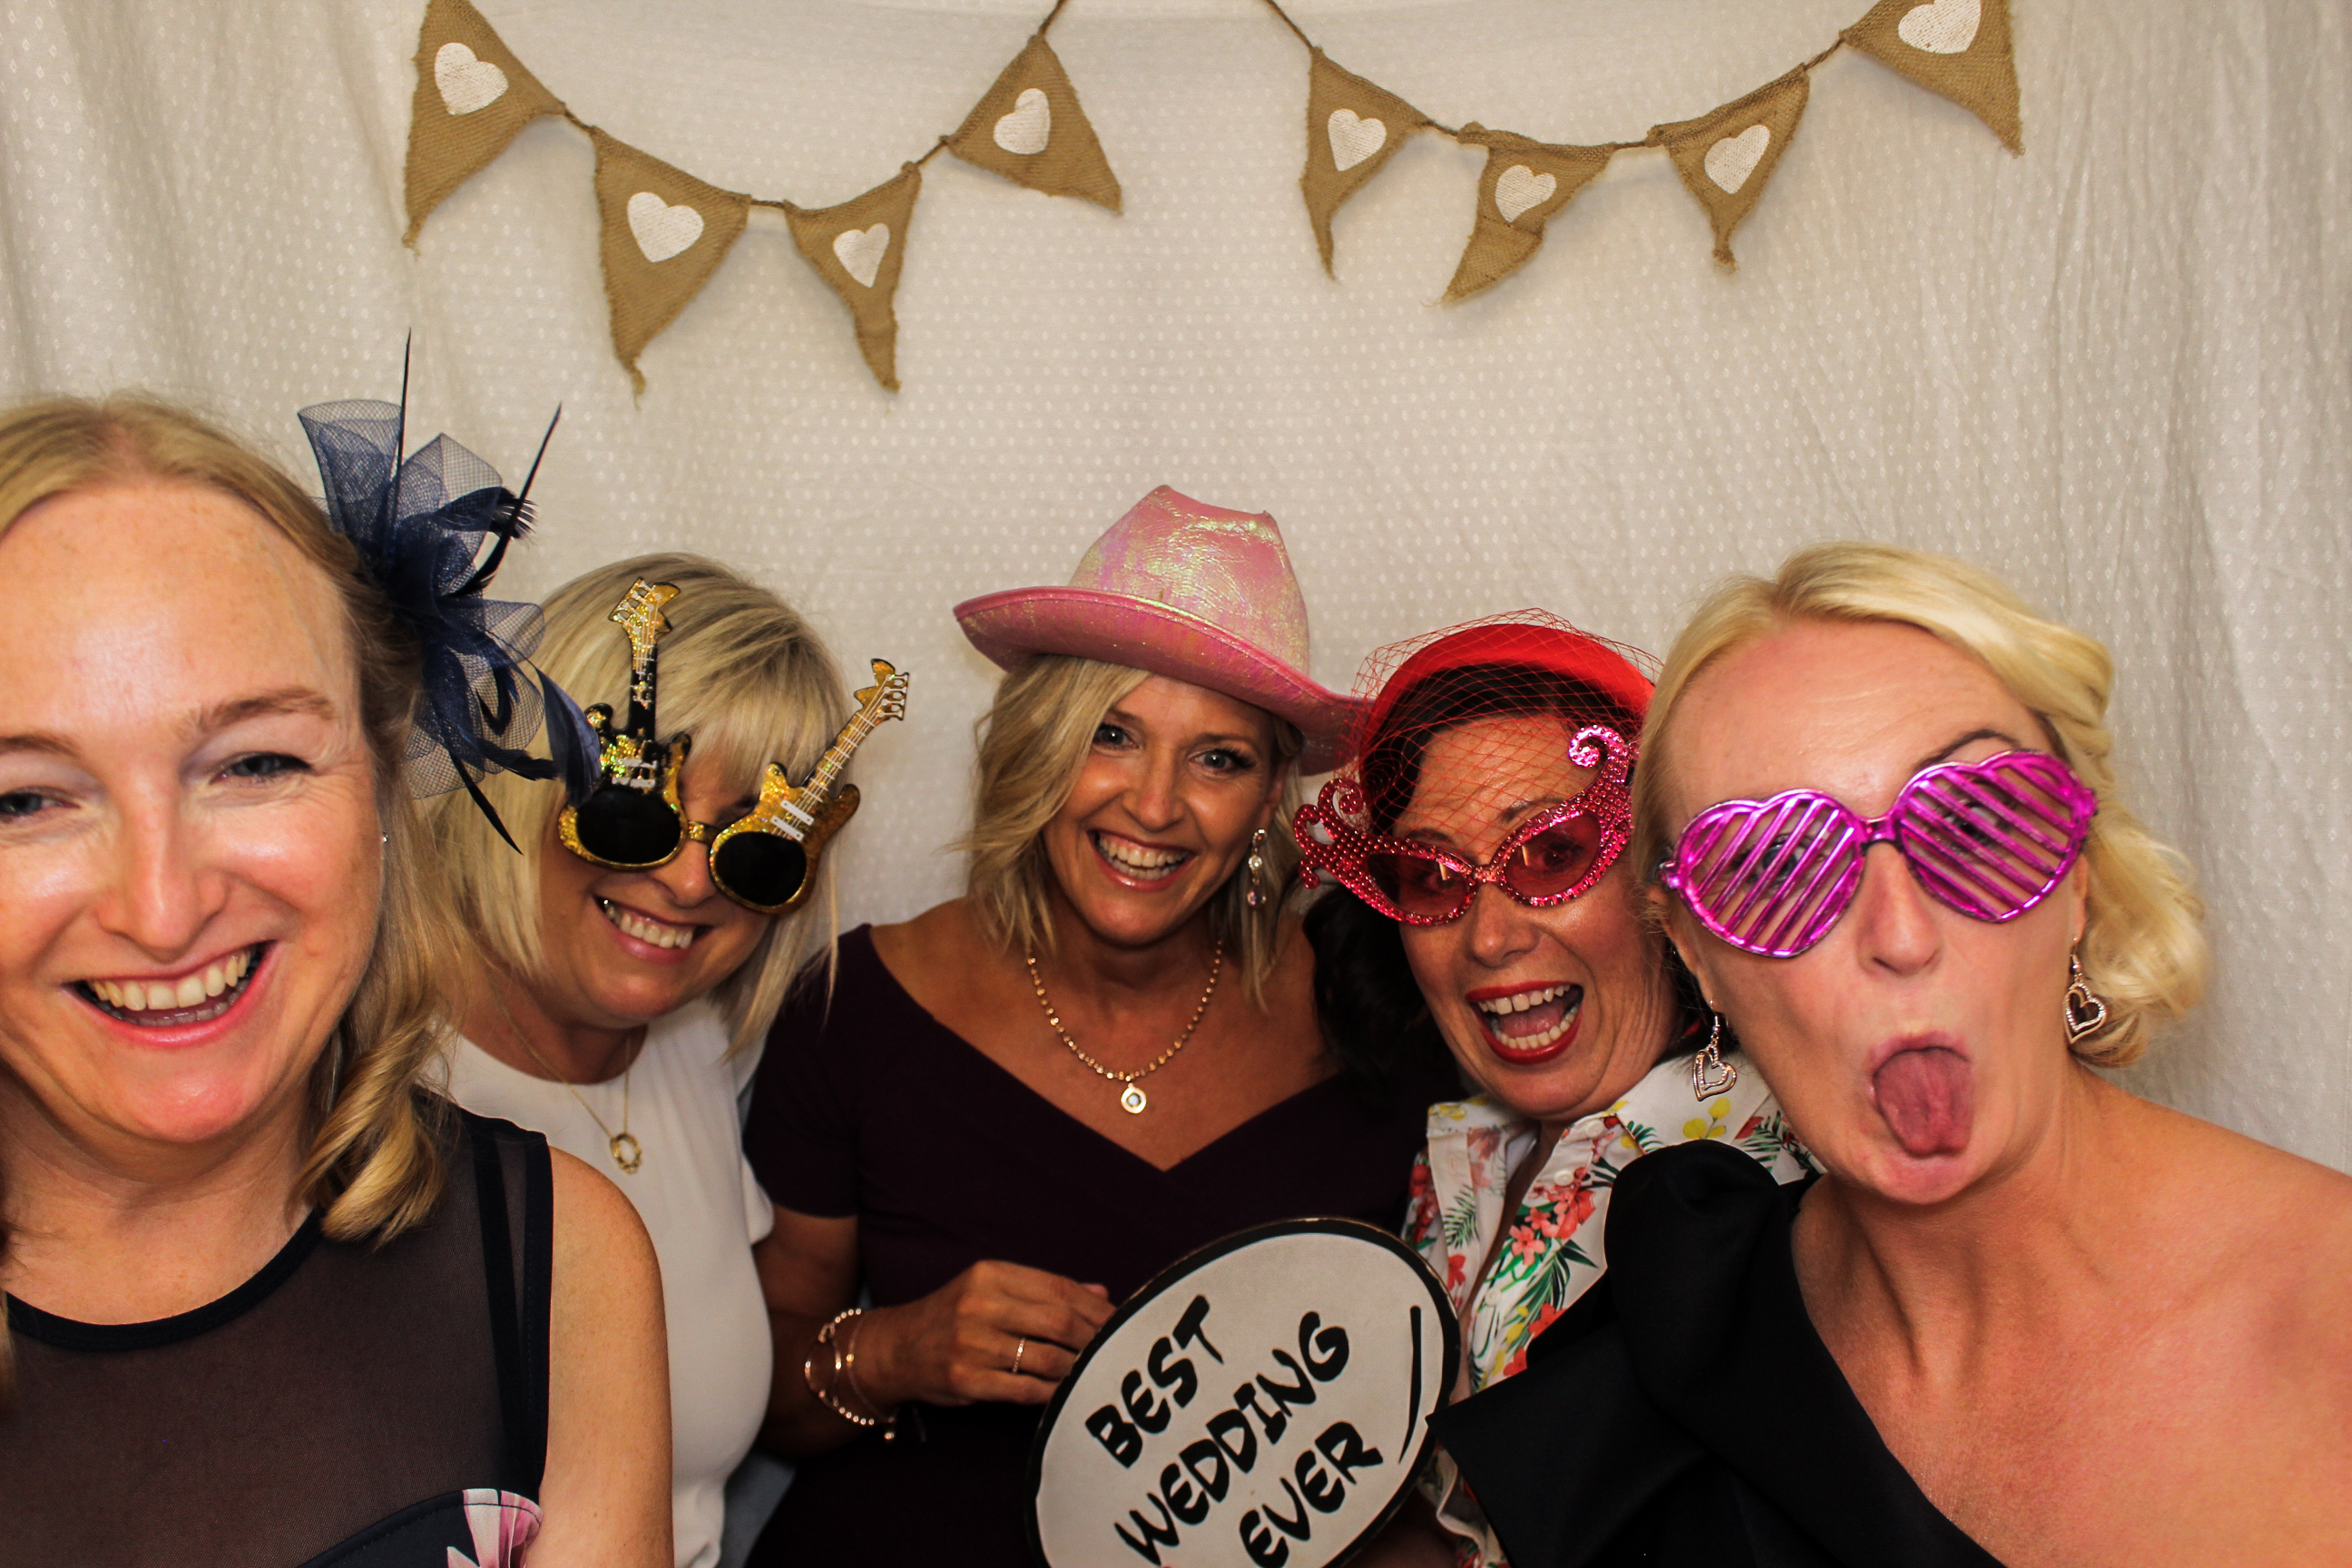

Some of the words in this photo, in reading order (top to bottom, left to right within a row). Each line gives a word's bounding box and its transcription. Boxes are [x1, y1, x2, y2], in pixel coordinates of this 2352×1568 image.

[1084, 1294, 1224, 1469] BEST
[1113, 1310, 1350, 1567] WEDDING
[1239, 1421, 1384, 1568] EVER
